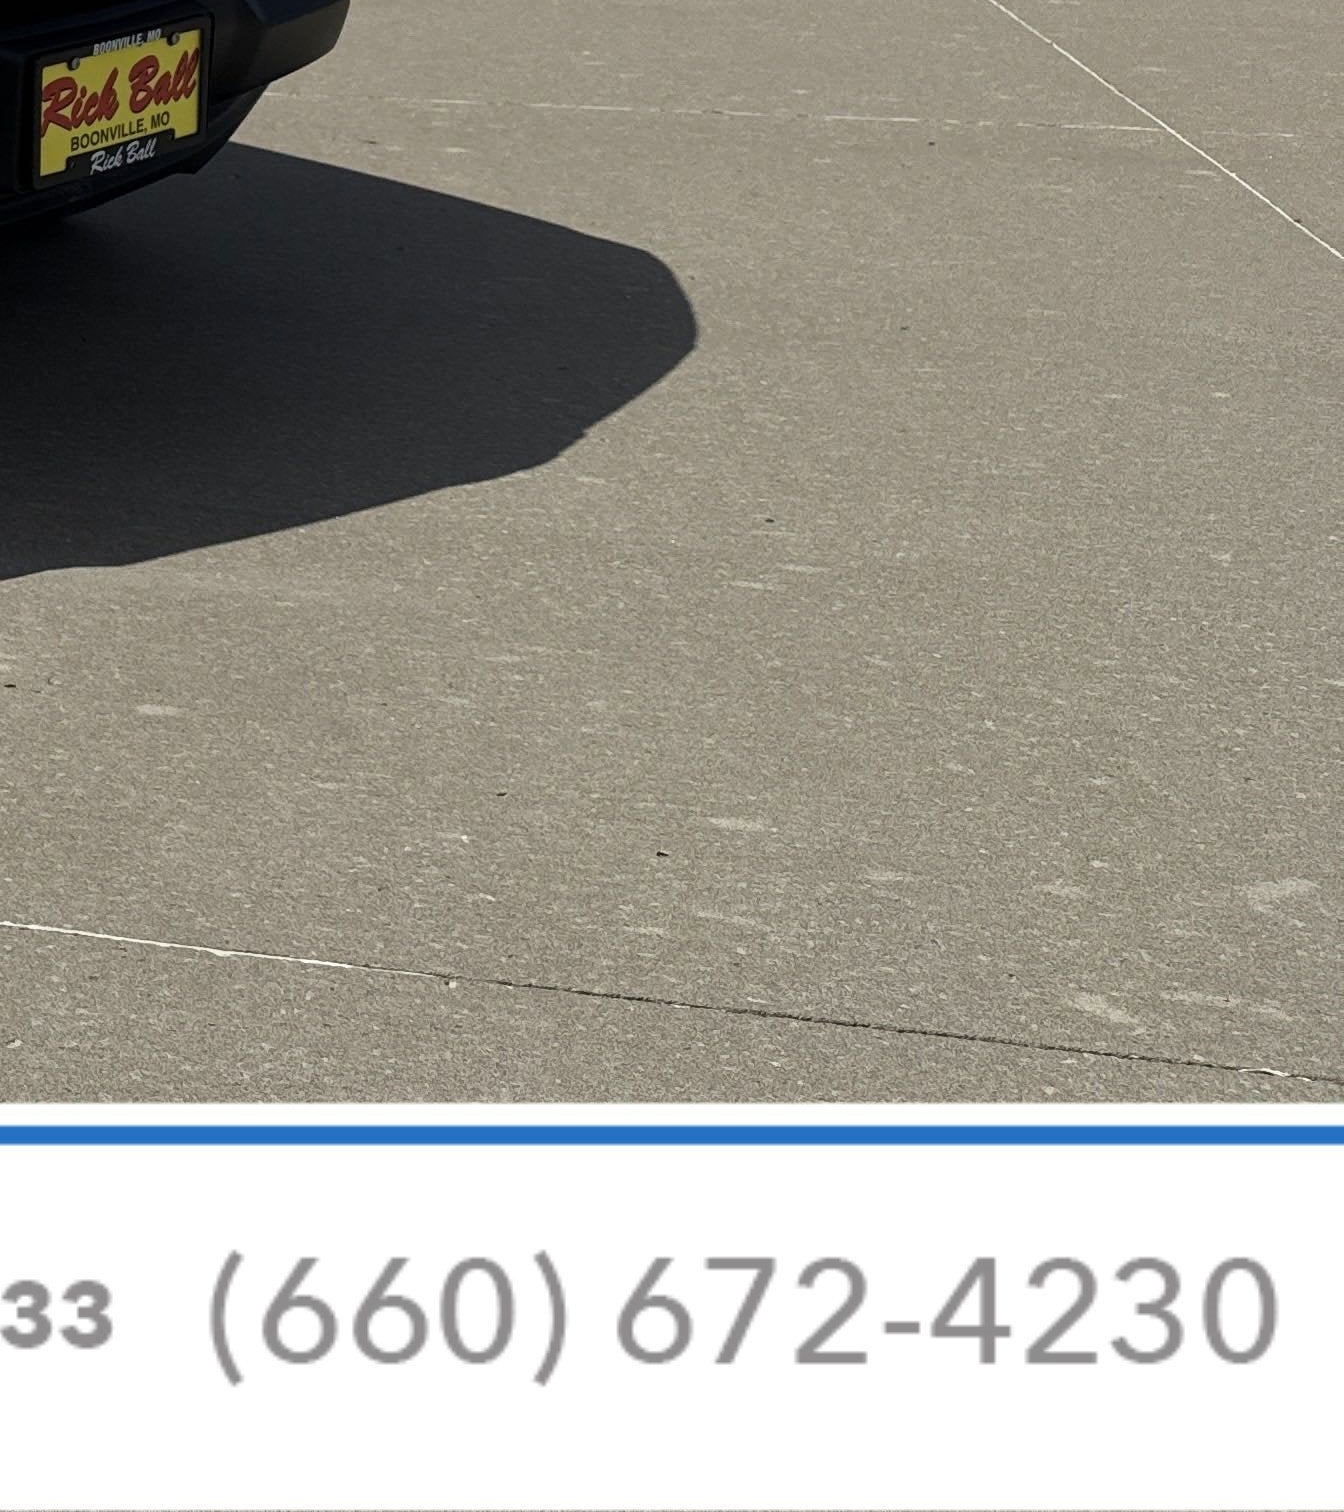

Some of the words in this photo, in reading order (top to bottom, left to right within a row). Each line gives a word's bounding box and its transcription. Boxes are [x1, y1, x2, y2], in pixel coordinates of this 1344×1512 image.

[147, 28, 162, 42] MO
[40, 66, 120, 138] Rick
[127, 47, 200, 114] Ball
[70, 119, 148, 152] BOONVILLE,
[150, 110, 170, 130] MO
[89, 144, 124, 175] Rick
[125, 137, 157, 165] Ball
